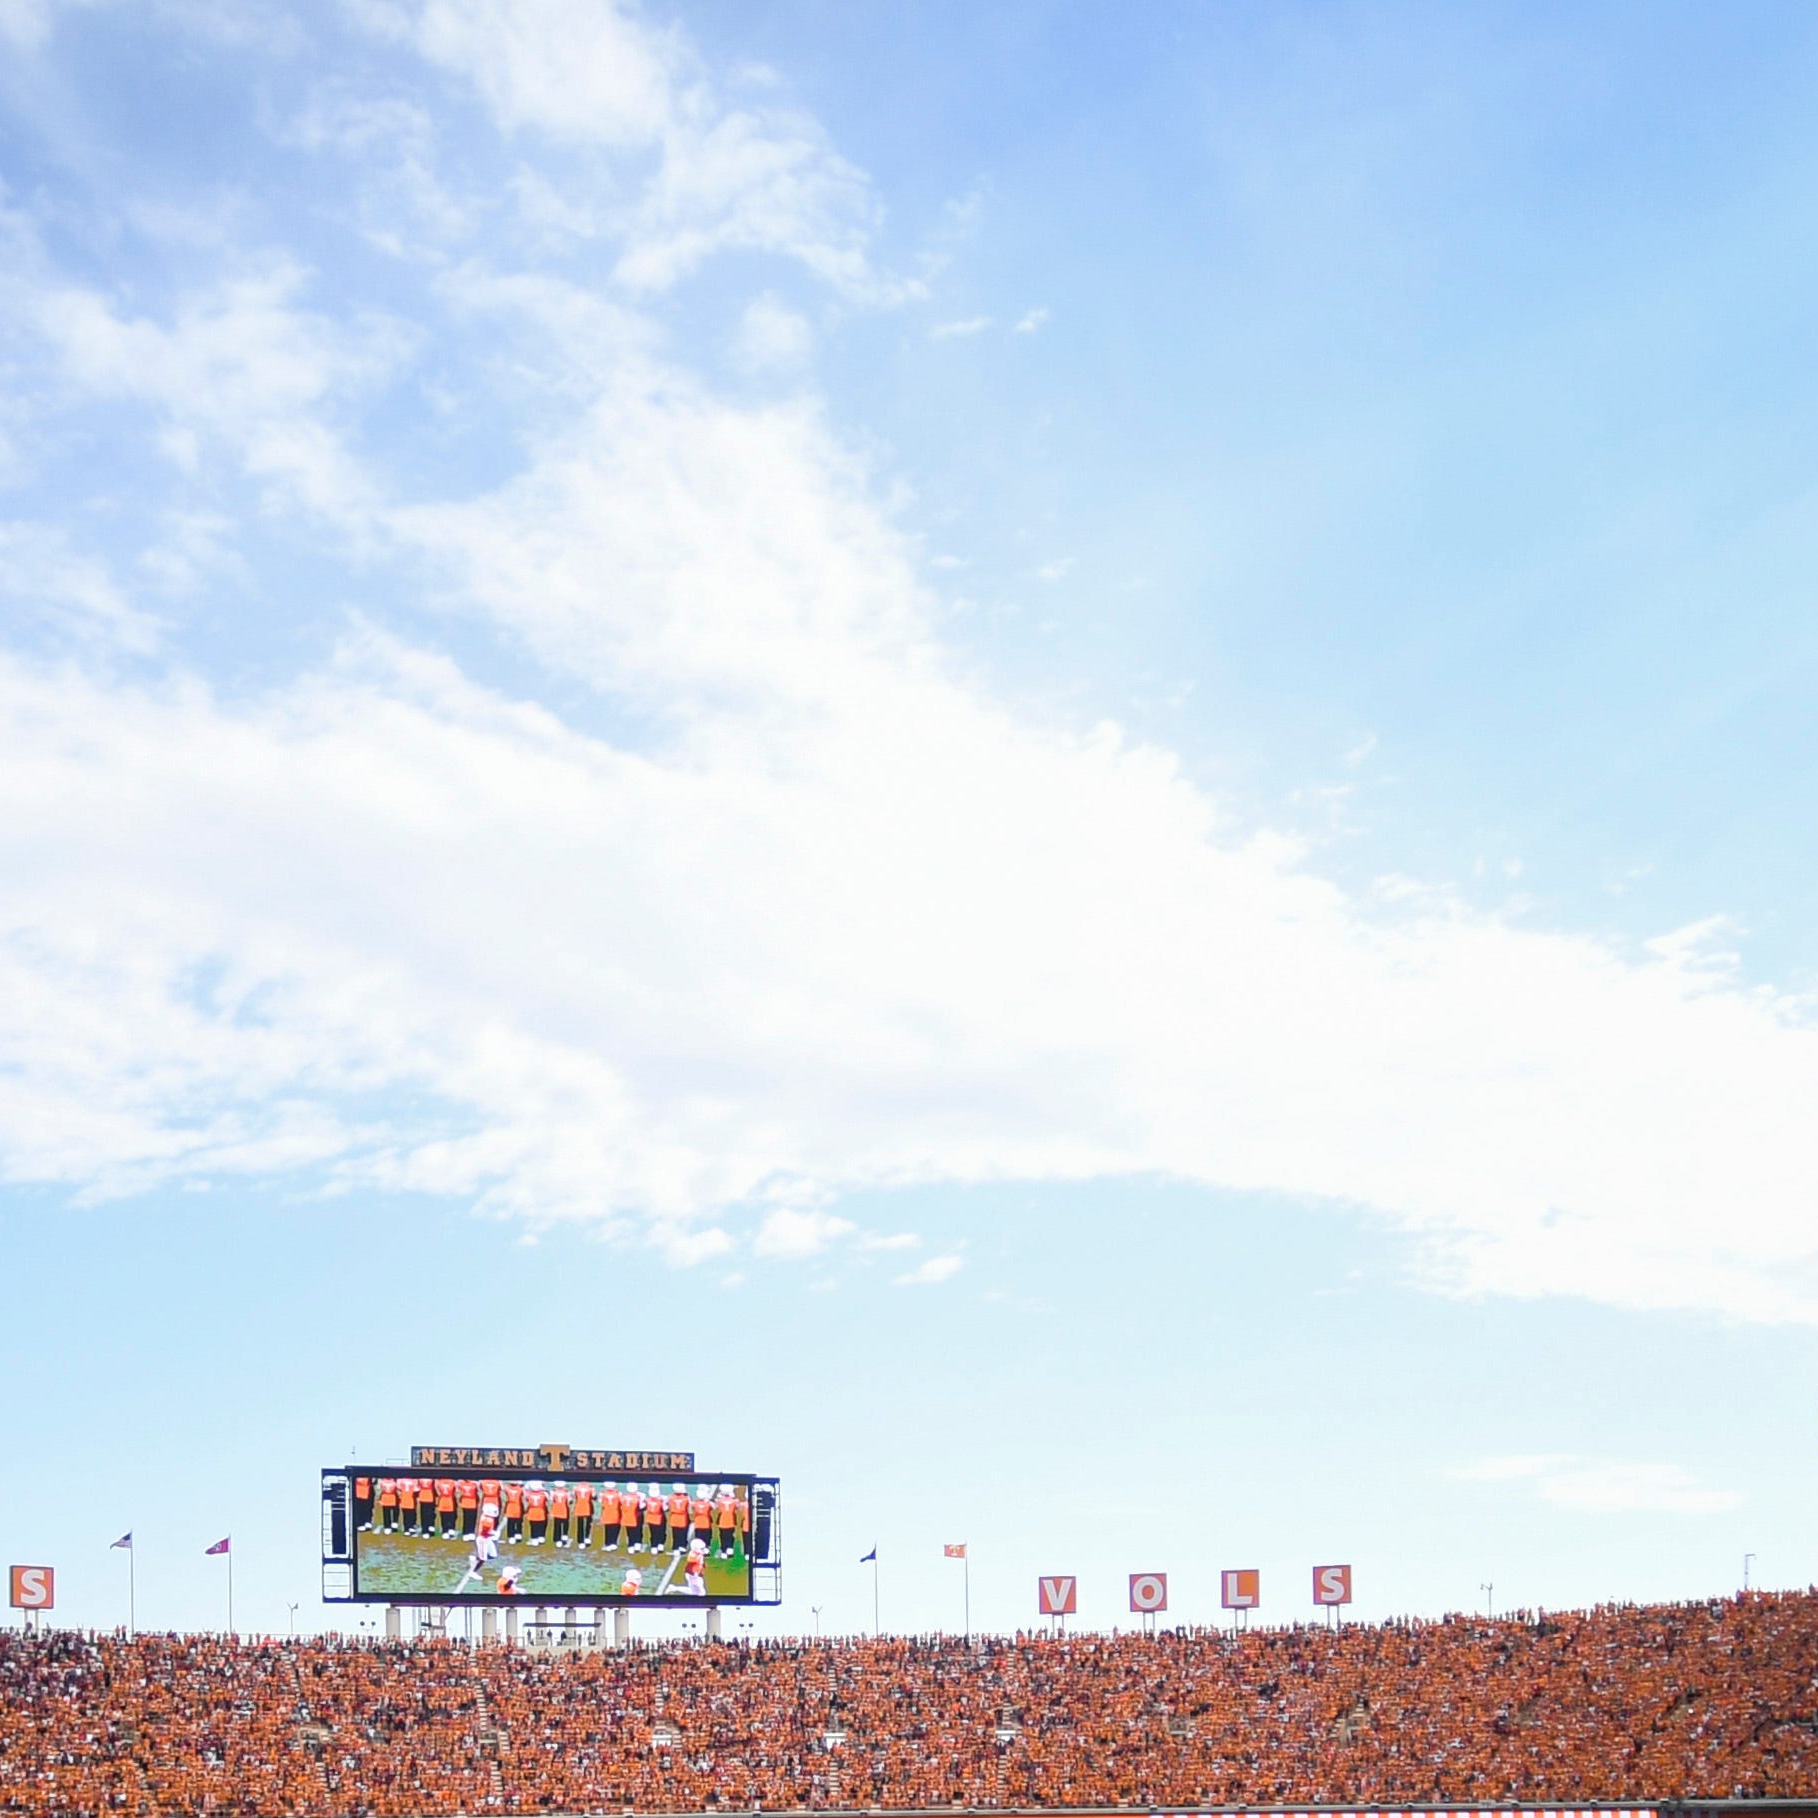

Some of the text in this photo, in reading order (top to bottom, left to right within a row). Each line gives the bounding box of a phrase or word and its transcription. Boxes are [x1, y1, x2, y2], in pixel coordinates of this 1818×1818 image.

[420, 1444, 687, 1472] NEYLAND T STADIUM
